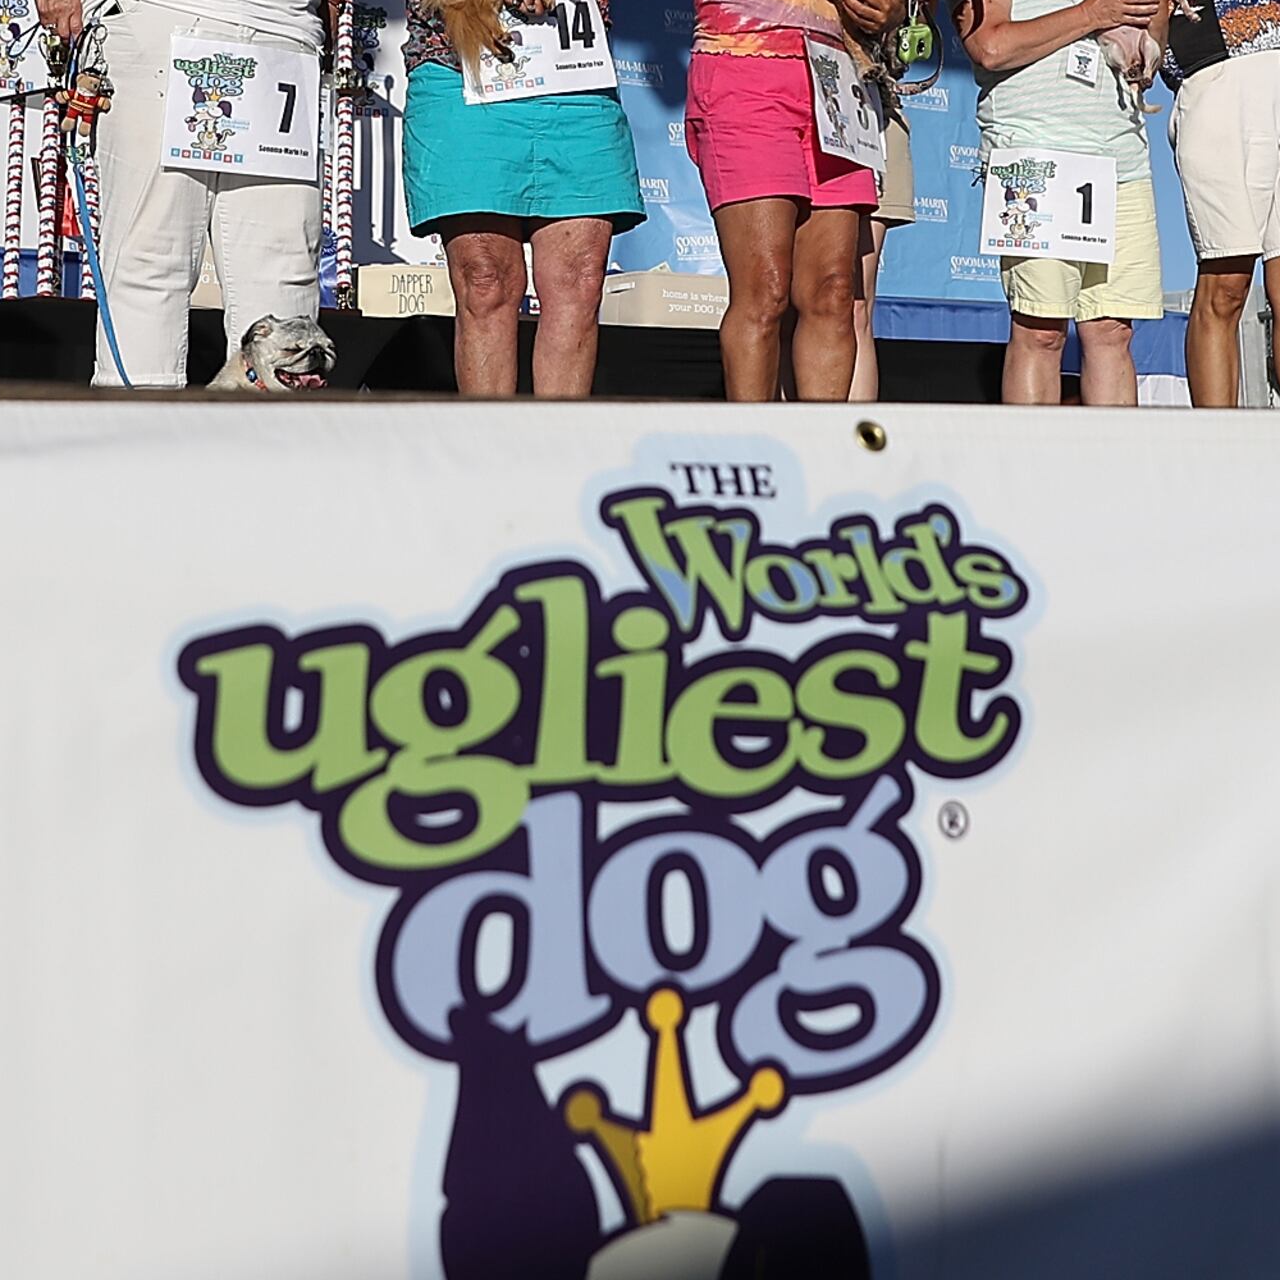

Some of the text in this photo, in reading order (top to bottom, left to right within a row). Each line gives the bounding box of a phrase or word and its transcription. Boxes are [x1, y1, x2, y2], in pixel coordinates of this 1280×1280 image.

[554, 1, 596, 51] 14
[188, 74, 244, 96] dog
[277, 82, 297, 133] 7
[1076, 182, 1093, 224] 1
[389, 274, 433, 294] DAPPER
[399, 294, 425, 314] DOG
[662, 288, 688, 299] home
[691, 292, 699, 300] is
[669, 304, 692, 313] your
[694, 305, 714, 313] DOG
[671, 463, 777, 501] THE
[604, 491, 1025, 639] World's
[182, 563, 1018, 880] ugliest
[380, 774, 938, 1092] dog
